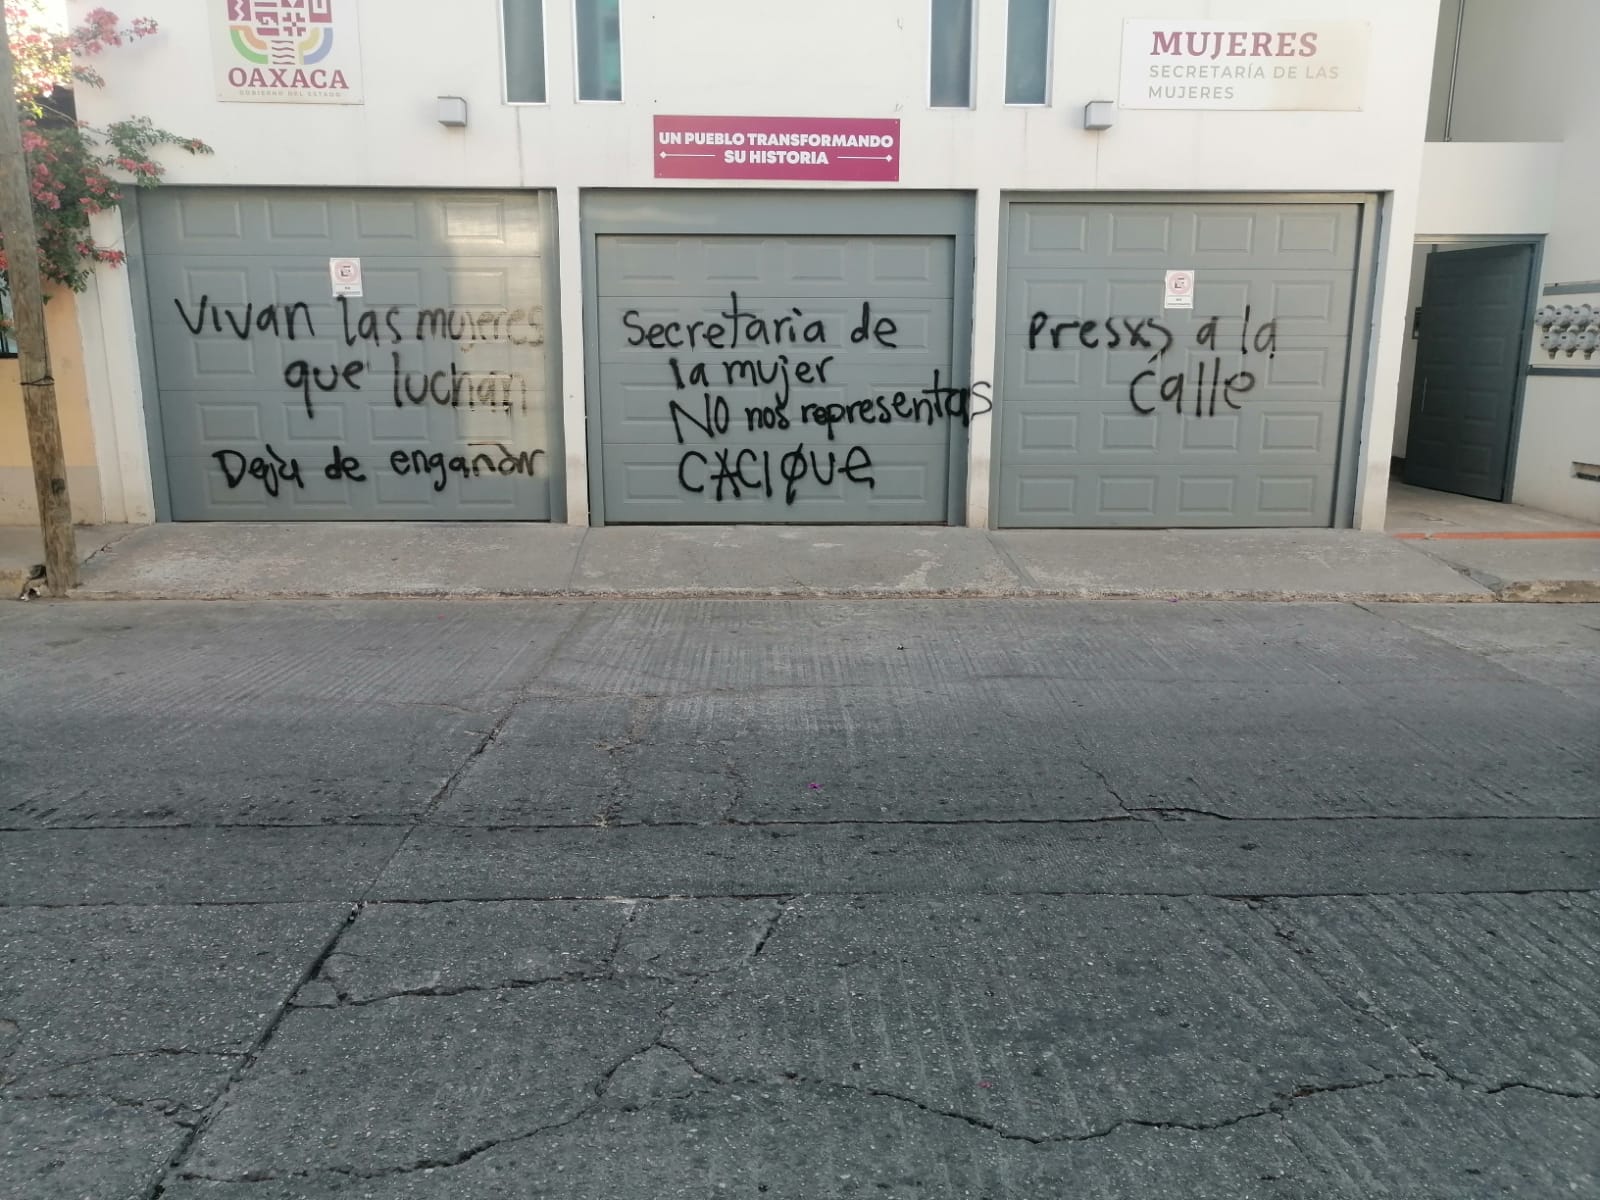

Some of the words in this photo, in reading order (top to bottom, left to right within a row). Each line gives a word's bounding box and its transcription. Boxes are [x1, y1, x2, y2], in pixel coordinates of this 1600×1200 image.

[1149, 31, 1319, 60] MUJERES
[228, 66, 350, 90] OAXACA
[1149, 63, 1266, 79] SECRETARÍA
[1273, 66, 1298, 80] DE
[1304, 66, 1340, 80] LAS
[1148, 85, 1235, 100] MUJERES
[658, 131, 682, 146] UN
[684, 131, 745, 146] PUEBLO
[747, 132, 894, 148] TRANSFORMANDO
[723, 150, 746, 164] SU
[749, 150, 829, 165] HISTORIA
[175, 294, 316, 341] Vivan
[336, 294, 403, 347] las
[415, 304, 546, 353] mujeres
[849, 301, 898, 348] de
[1196, 315, 1219, 352] a
[1241, 304, 1277, 360] la
[283, 359, 366, 420] que
[391, 351, 527, 417] luchan
[721, 354, 834, 408] mujer
[744, 399, 791, 432] nos
[800, 368, 993, 441] representas
[323, 445, 368, 483] de
